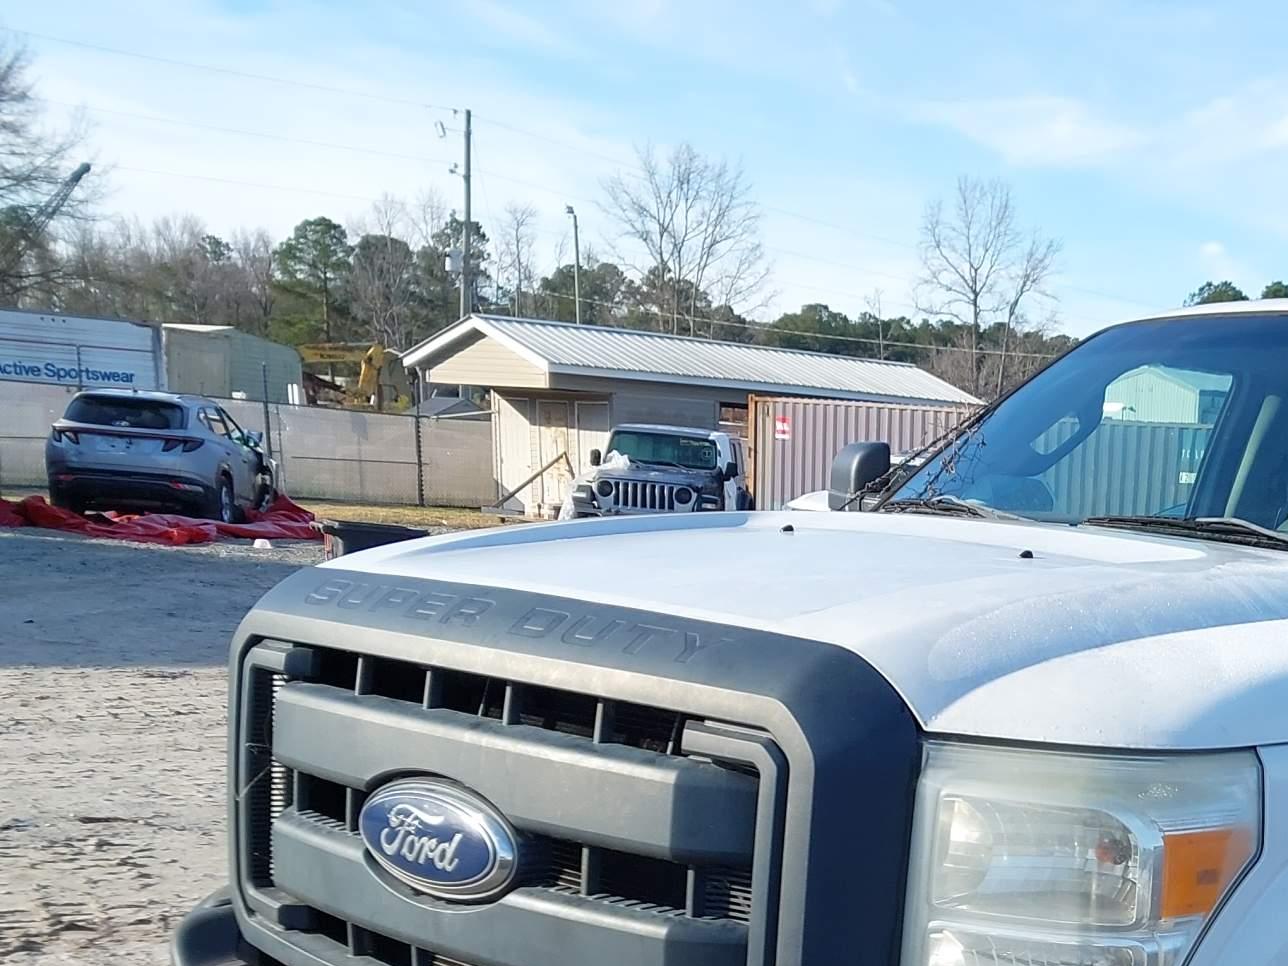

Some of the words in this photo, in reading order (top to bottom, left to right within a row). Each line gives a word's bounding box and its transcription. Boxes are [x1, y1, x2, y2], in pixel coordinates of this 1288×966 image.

[44, 362, 135, 383] Sportswear
[304, 579, 496, 628] SUPER
[507, 607, 732, 663] DUTY
[380, 804, 463, 872] Ford
